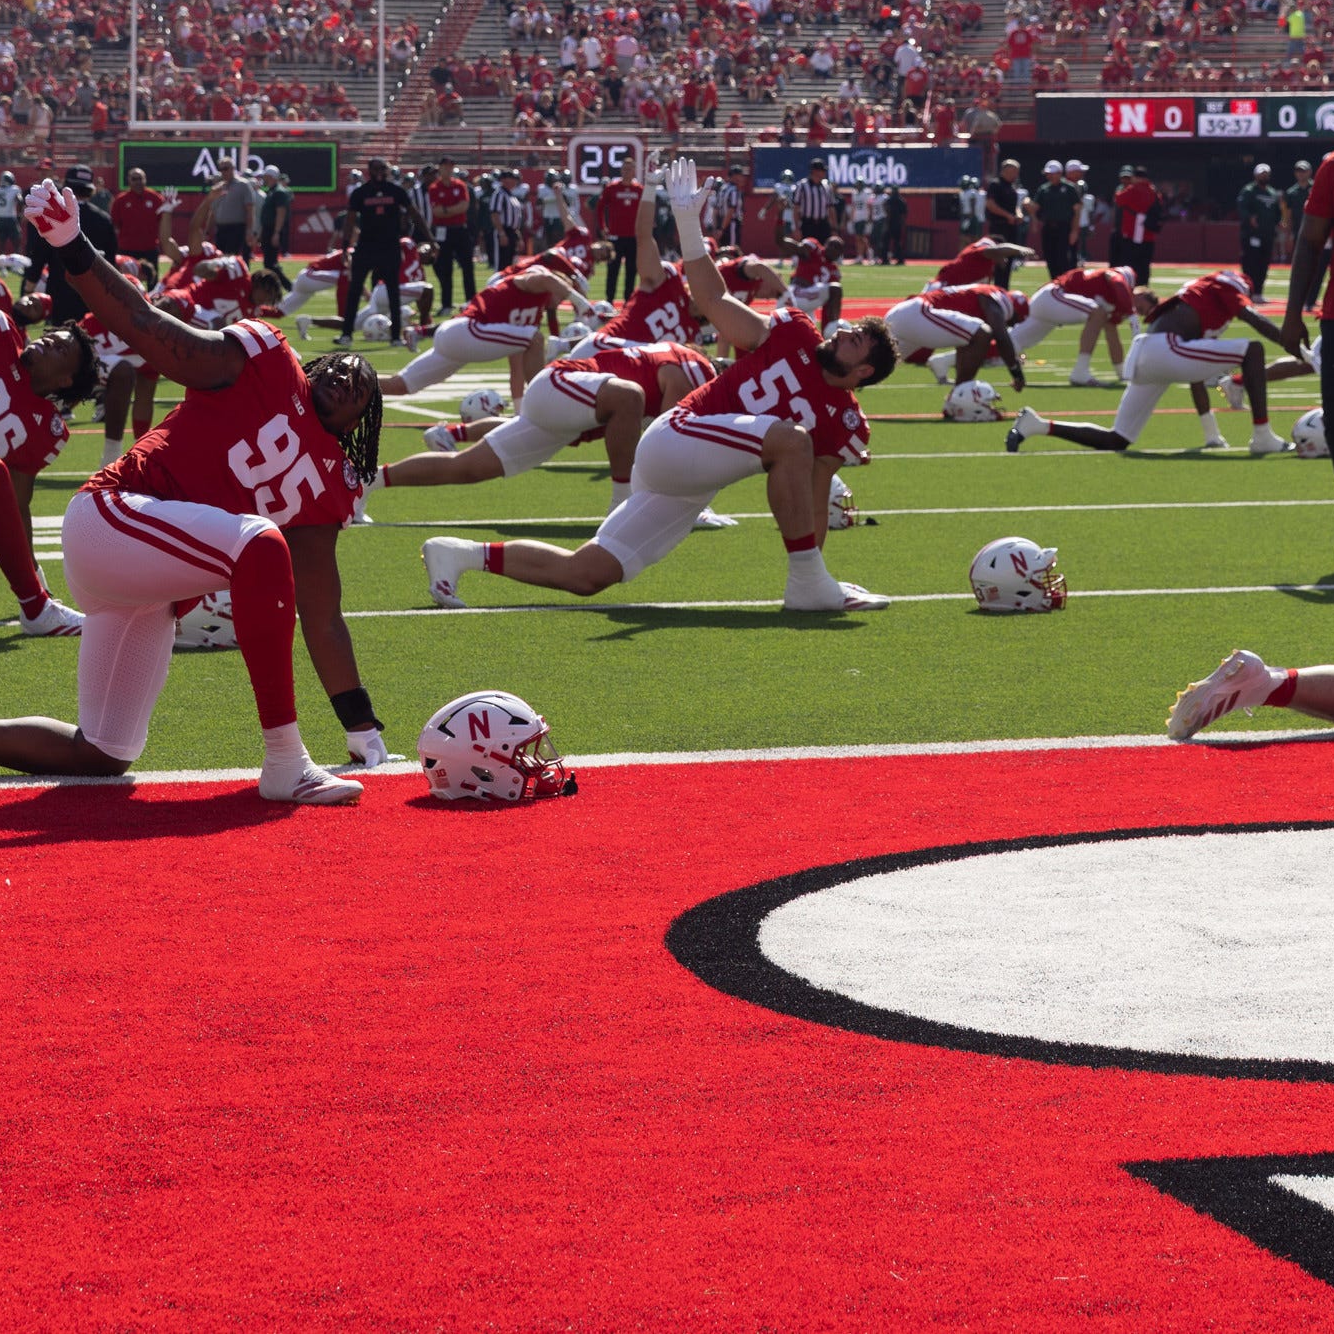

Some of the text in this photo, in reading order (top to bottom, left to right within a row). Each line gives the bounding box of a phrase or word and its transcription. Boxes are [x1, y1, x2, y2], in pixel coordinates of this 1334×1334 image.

[1119, 103, 1183, 133] N 0
[1206, 118, 1252, 134] 39:37
[1278, 105, 1297, 129] 0
[828, 154, 908, 186] Modelo
[228, 413, 326, 527] 95
[1009, 550, 1028, 576] N
[468, 710, 490, 741] N
